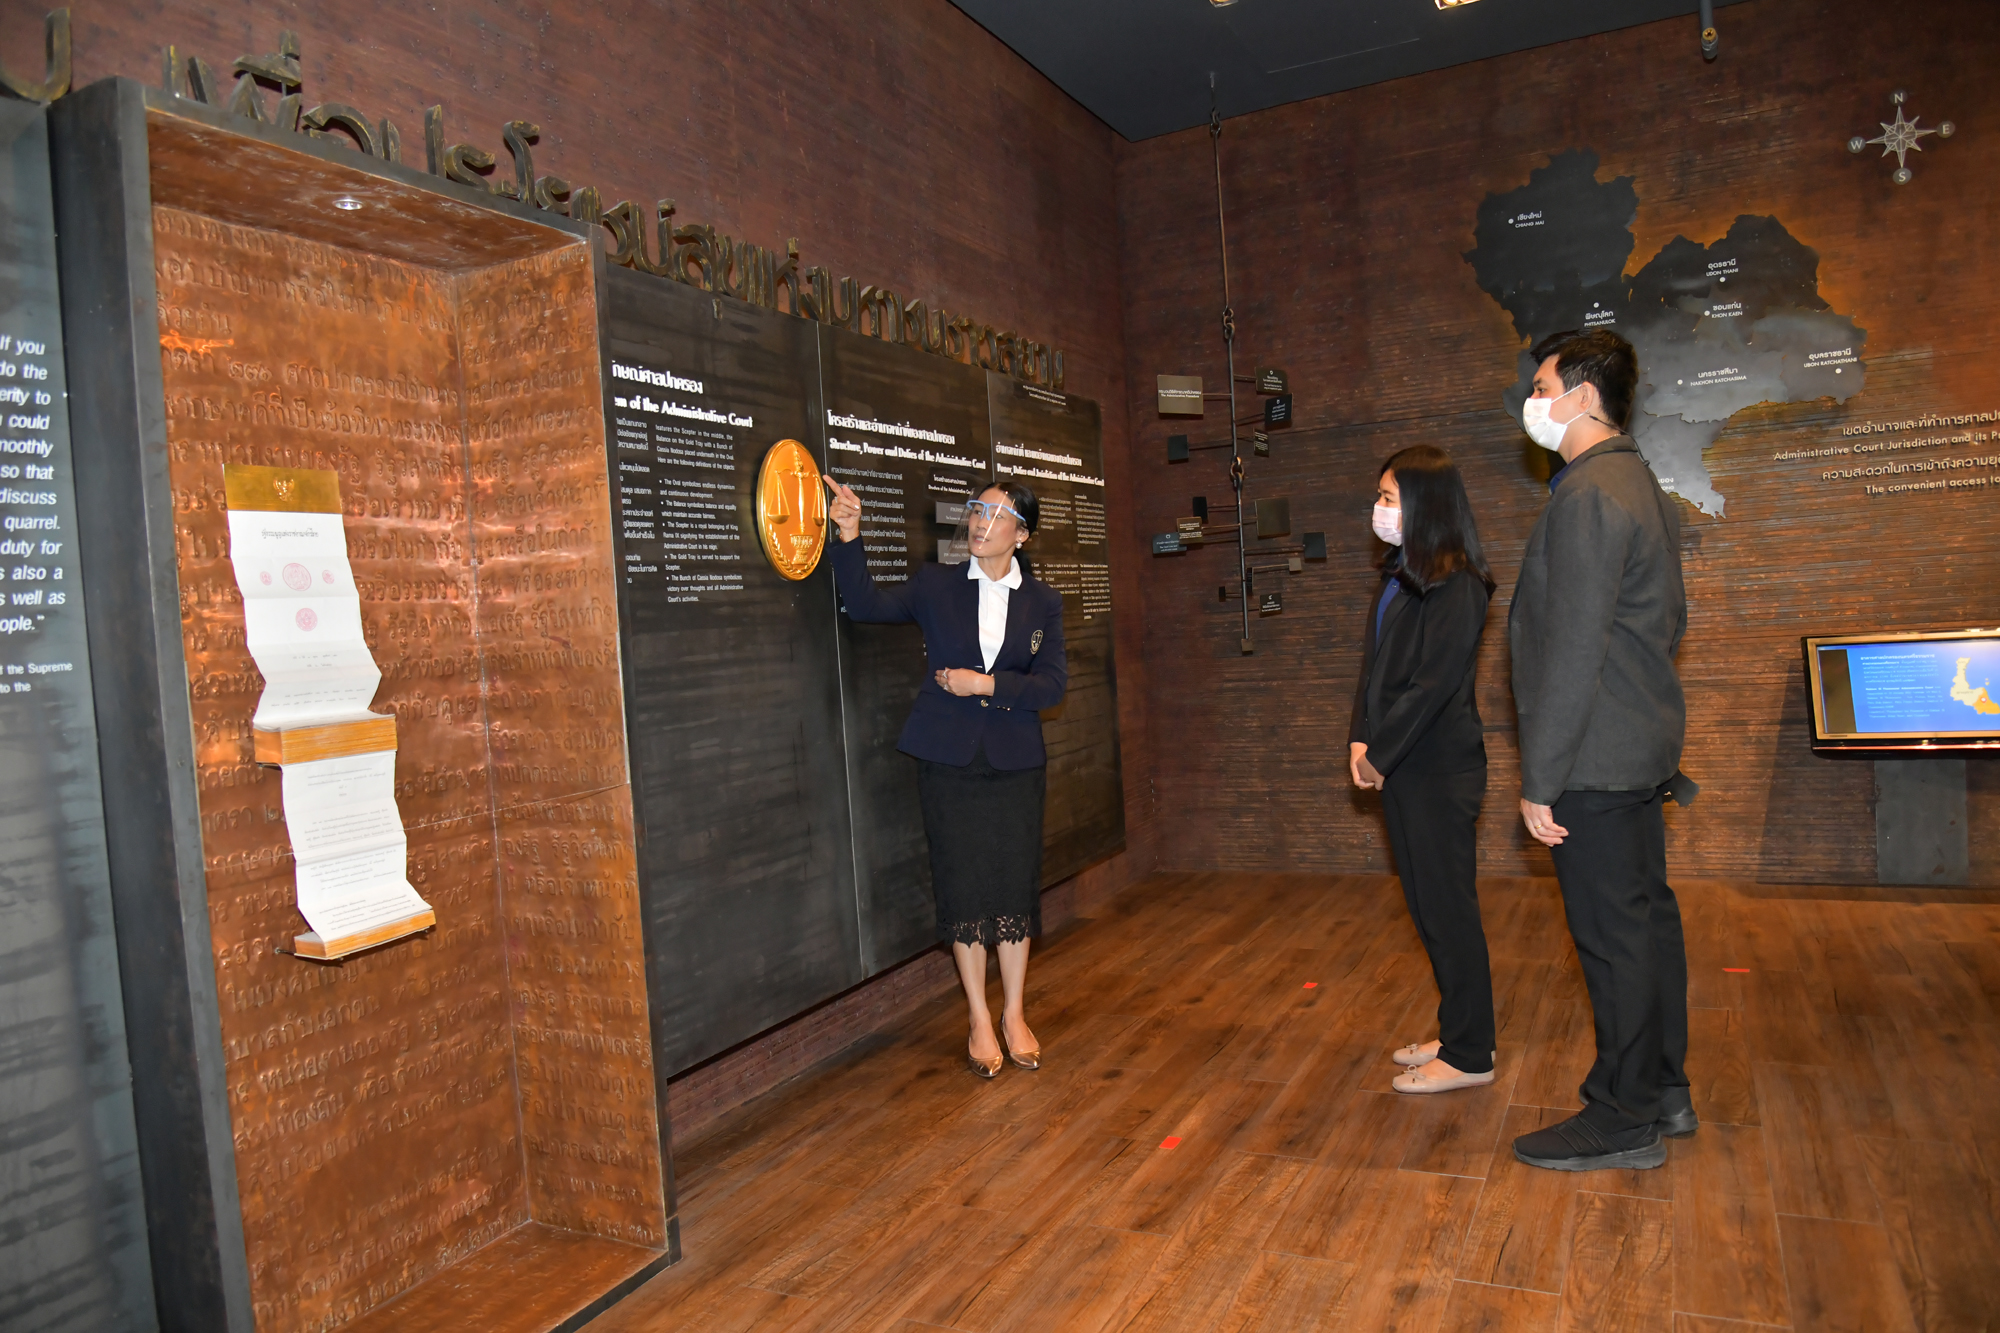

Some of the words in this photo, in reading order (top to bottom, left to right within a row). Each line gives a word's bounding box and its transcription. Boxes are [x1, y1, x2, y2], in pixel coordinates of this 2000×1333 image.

[1895, 93, 1903, 103] N
[1943, 124, 1950, 134] E
[1851, 140, 1862, 150] W
[1899, 172, 1906, 181] S
[1584, 319, 1616, 327] PHITSANULOK
[16, 340, 45, 355] you
[1820, 357, 1857, 367] RATCHATHANI
[23, 364, 47, 380] the
[1691, 379, 1713, 387] NAKHON
[1715, 375, 1746, 383] RATCHASIMA
[35, 391, 51, 405] to
[630, 395, 641, 410] of
[643, 398, 659, 413] the
[661, 401, 727, 424] Administrative
[729, 413, 753, 427] Court
[8, 415, 50, 430] could
[830, 438, 862, 455] Structure,
[863, 442, 883, 455] Power
[885, 446, 897, 457] and
[898, 447, 917, 459] Duties
[918, 450, 924, 460] of
[925, 451, 934, 462] the
[936, 452, 971, 467] Administrative
[973, 458, 986, 469] Court
[1774, 447, 1849, 460] Administrative
[1853, 442, 1883, 453] Court
[1887, 437, 1947, 450] Jurisdiction
[1951, 433, 1970, 443] and
[1975, 432, 1987, 442] its
[1, 465, 19, 478] so
[26, 464, 53, 480] that
[1865, 485, 1884, 495] The
[1888, 480, 1946, 492] convenient
[1950, 477, 1986, 487] access
[1990, 476, 2000, 484] to
[4, 515, 60, 532] quarrel.
[0, 539, 34, 558] duty
[41, 540, 62, 555] for
[12, 565, 47, 580] also
[54, 568, 63, 580] a
[12, 590, 42, 605] well
[48, 592, 66, 605] as
[7, 664, 24, 675] the
[28, 662, 73, 675] Supreme
[14, 682, 31, 692] the
